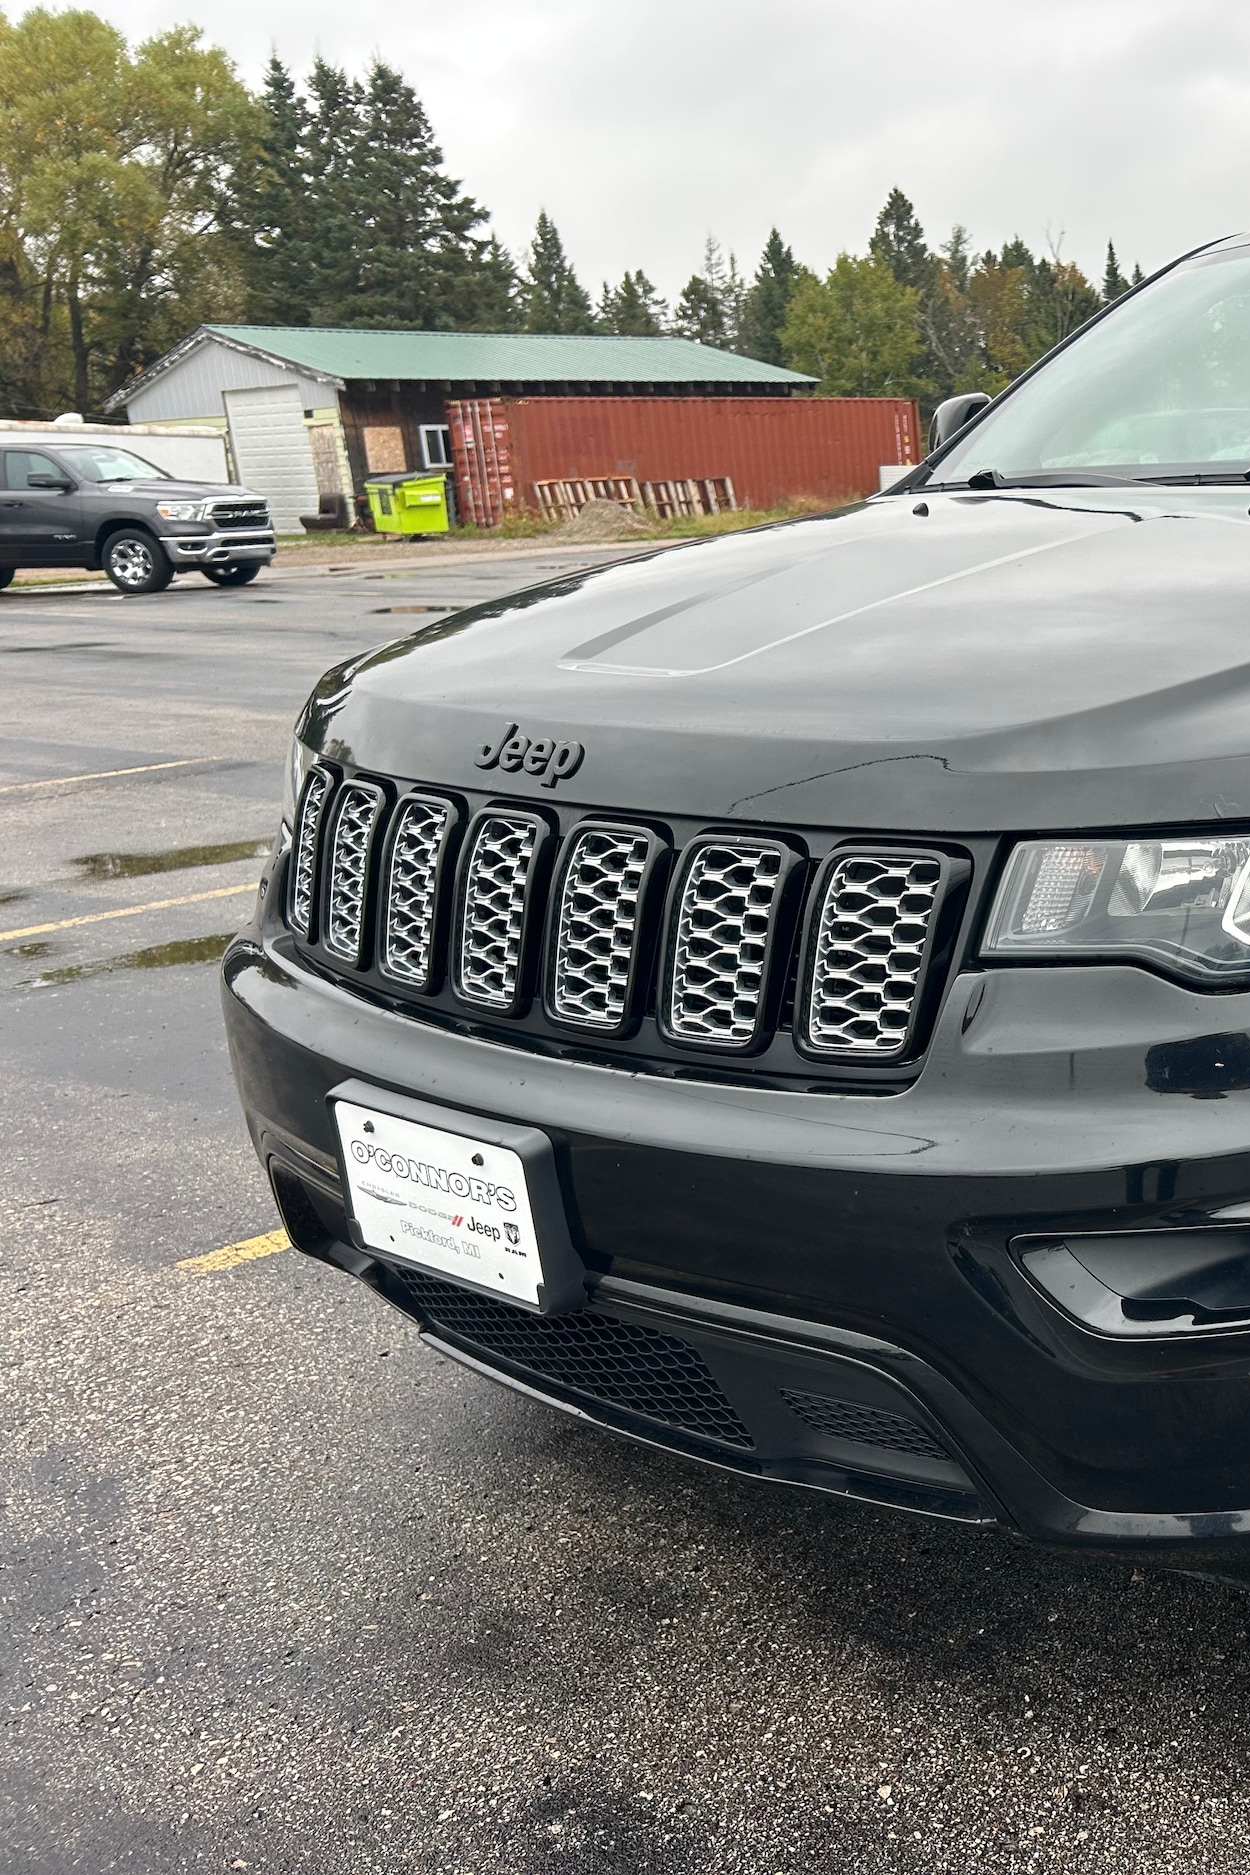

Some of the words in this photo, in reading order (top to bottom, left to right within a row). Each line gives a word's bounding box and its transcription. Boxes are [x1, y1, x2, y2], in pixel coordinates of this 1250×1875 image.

[474, 722, 585, 788] Jeep
[350, 1140, 517, 1212] O'CONNOR'S
[361, 1180, 400, 1198] CHRYSLER
[408, 1201, 454, 1221] DODGE
[400, 1220, 460, 1254] Pickford,
[461, 1240, 481, 1259] MI
[467, 1216, 501, 1242] Jeep
[505, 1247, 527, 1258] RAM
